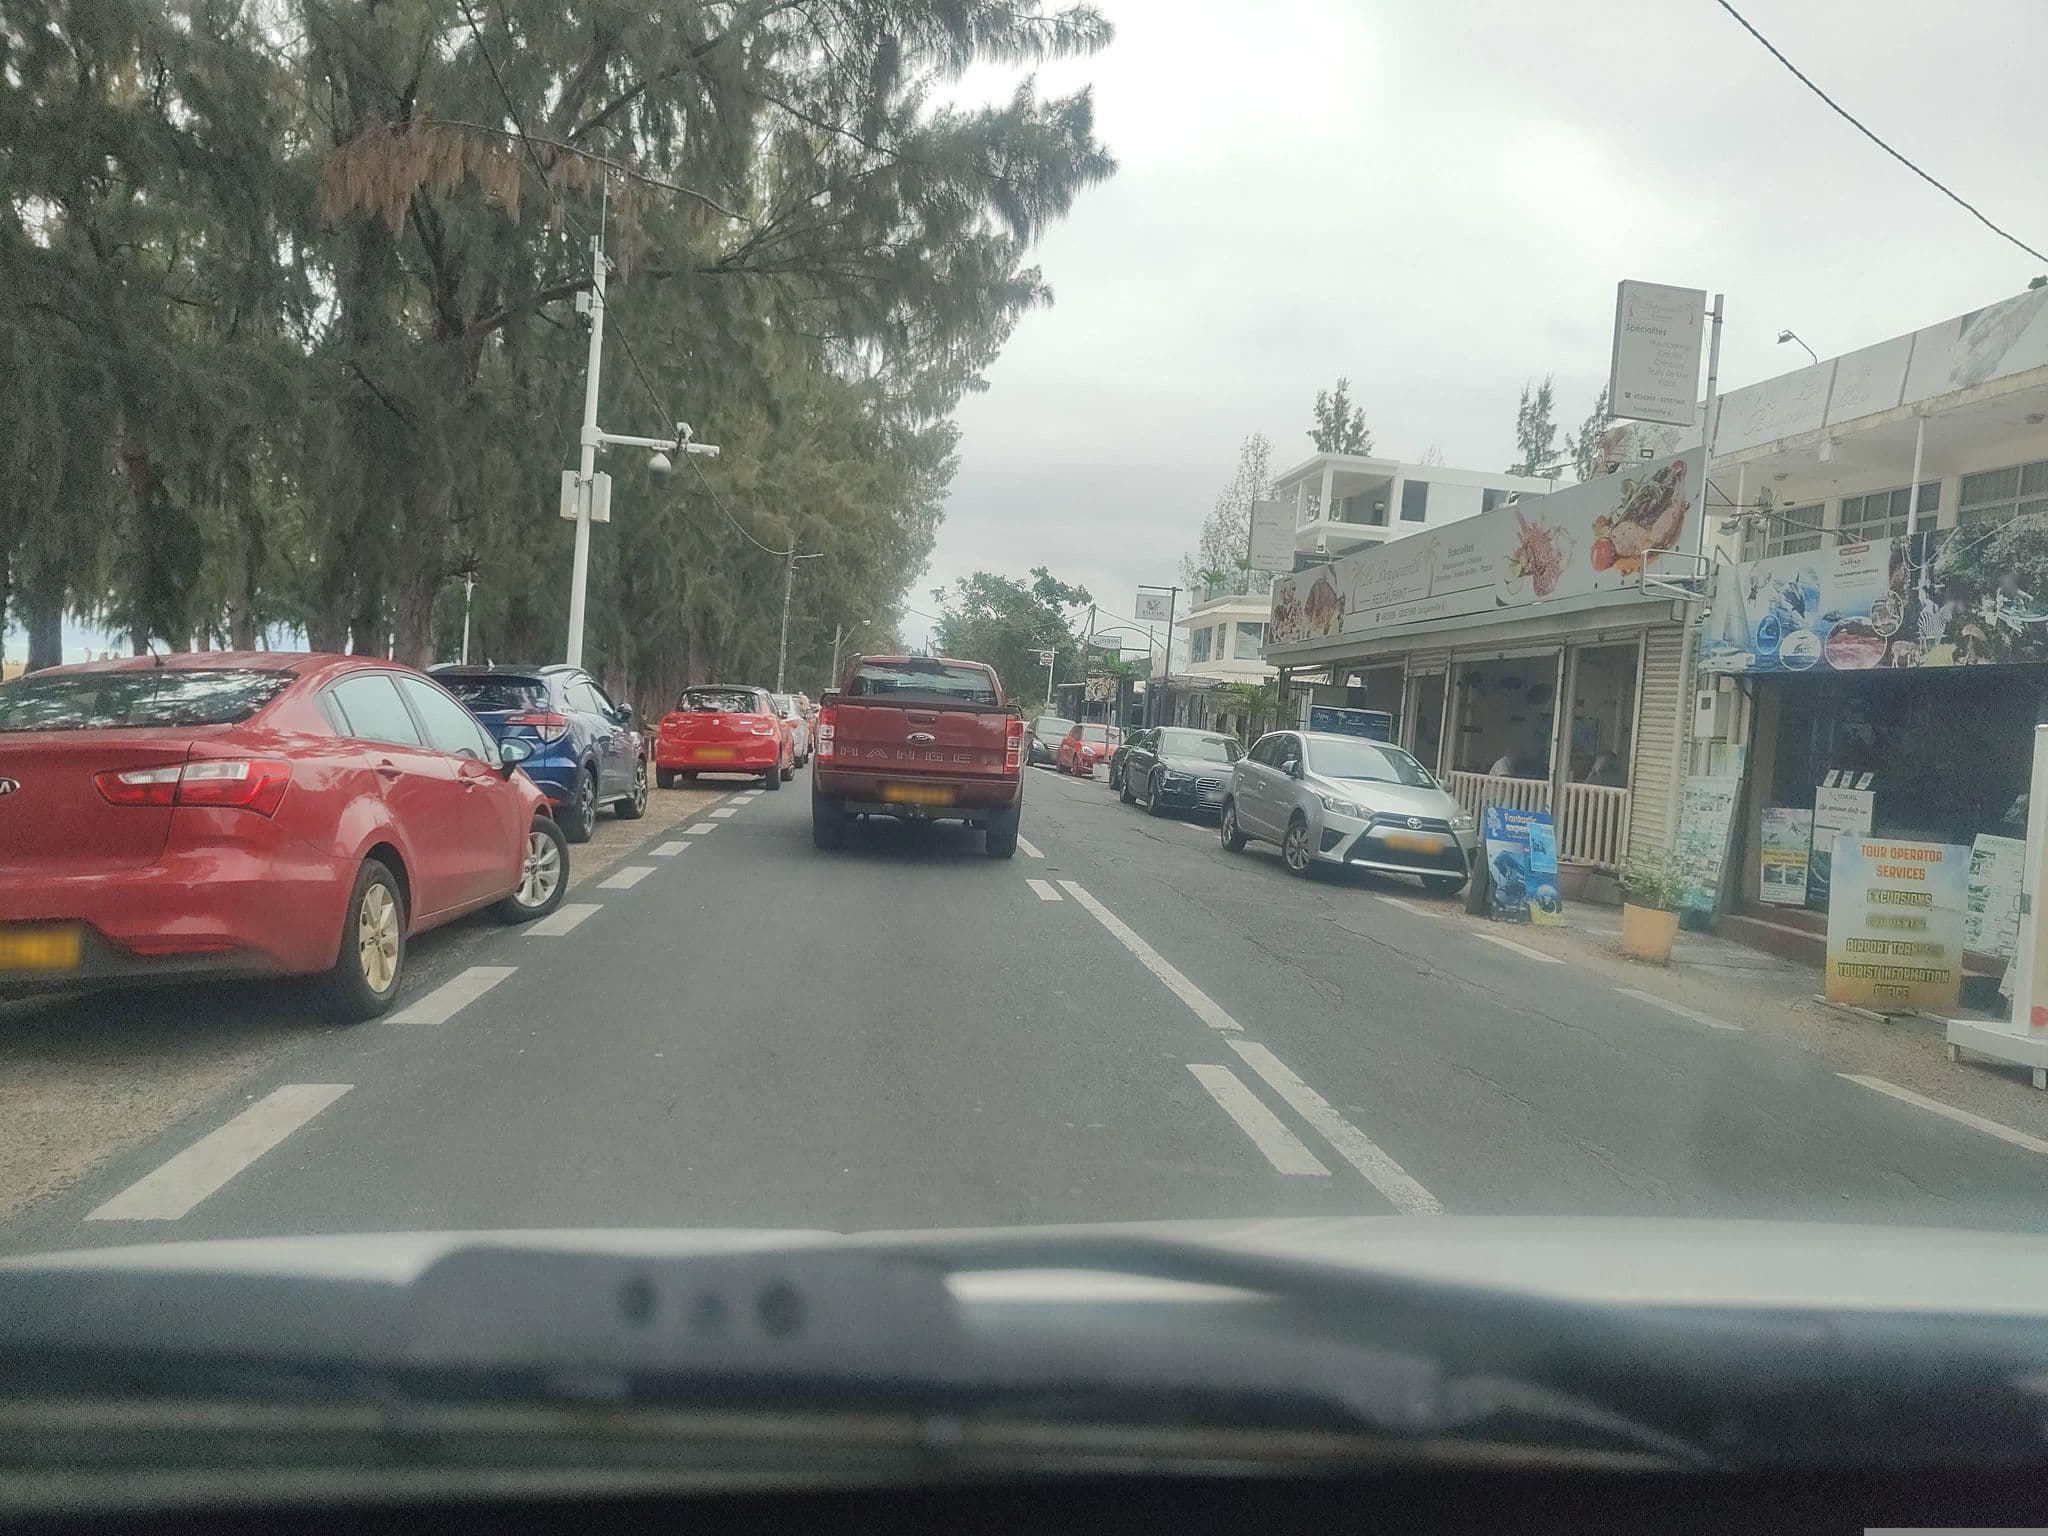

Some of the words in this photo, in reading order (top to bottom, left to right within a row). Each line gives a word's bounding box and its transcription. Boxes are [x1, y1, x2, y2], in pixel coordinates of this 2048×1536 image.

[840, 745, 972, 765] RANGE
[1861, 844, 1887, 858] TOUR
[1890, 846, 1943, 863] OPERATOR
[1876, 864, 1926, 880] SERVICES
[1867, 888, 1933, 907] EXCURSIONS
[1846, 938, 1891, 954] AIRPORT
[1838, 963, 1880, 979] TOURIST
[1881, 966, 1950, 984] INFORMATION
